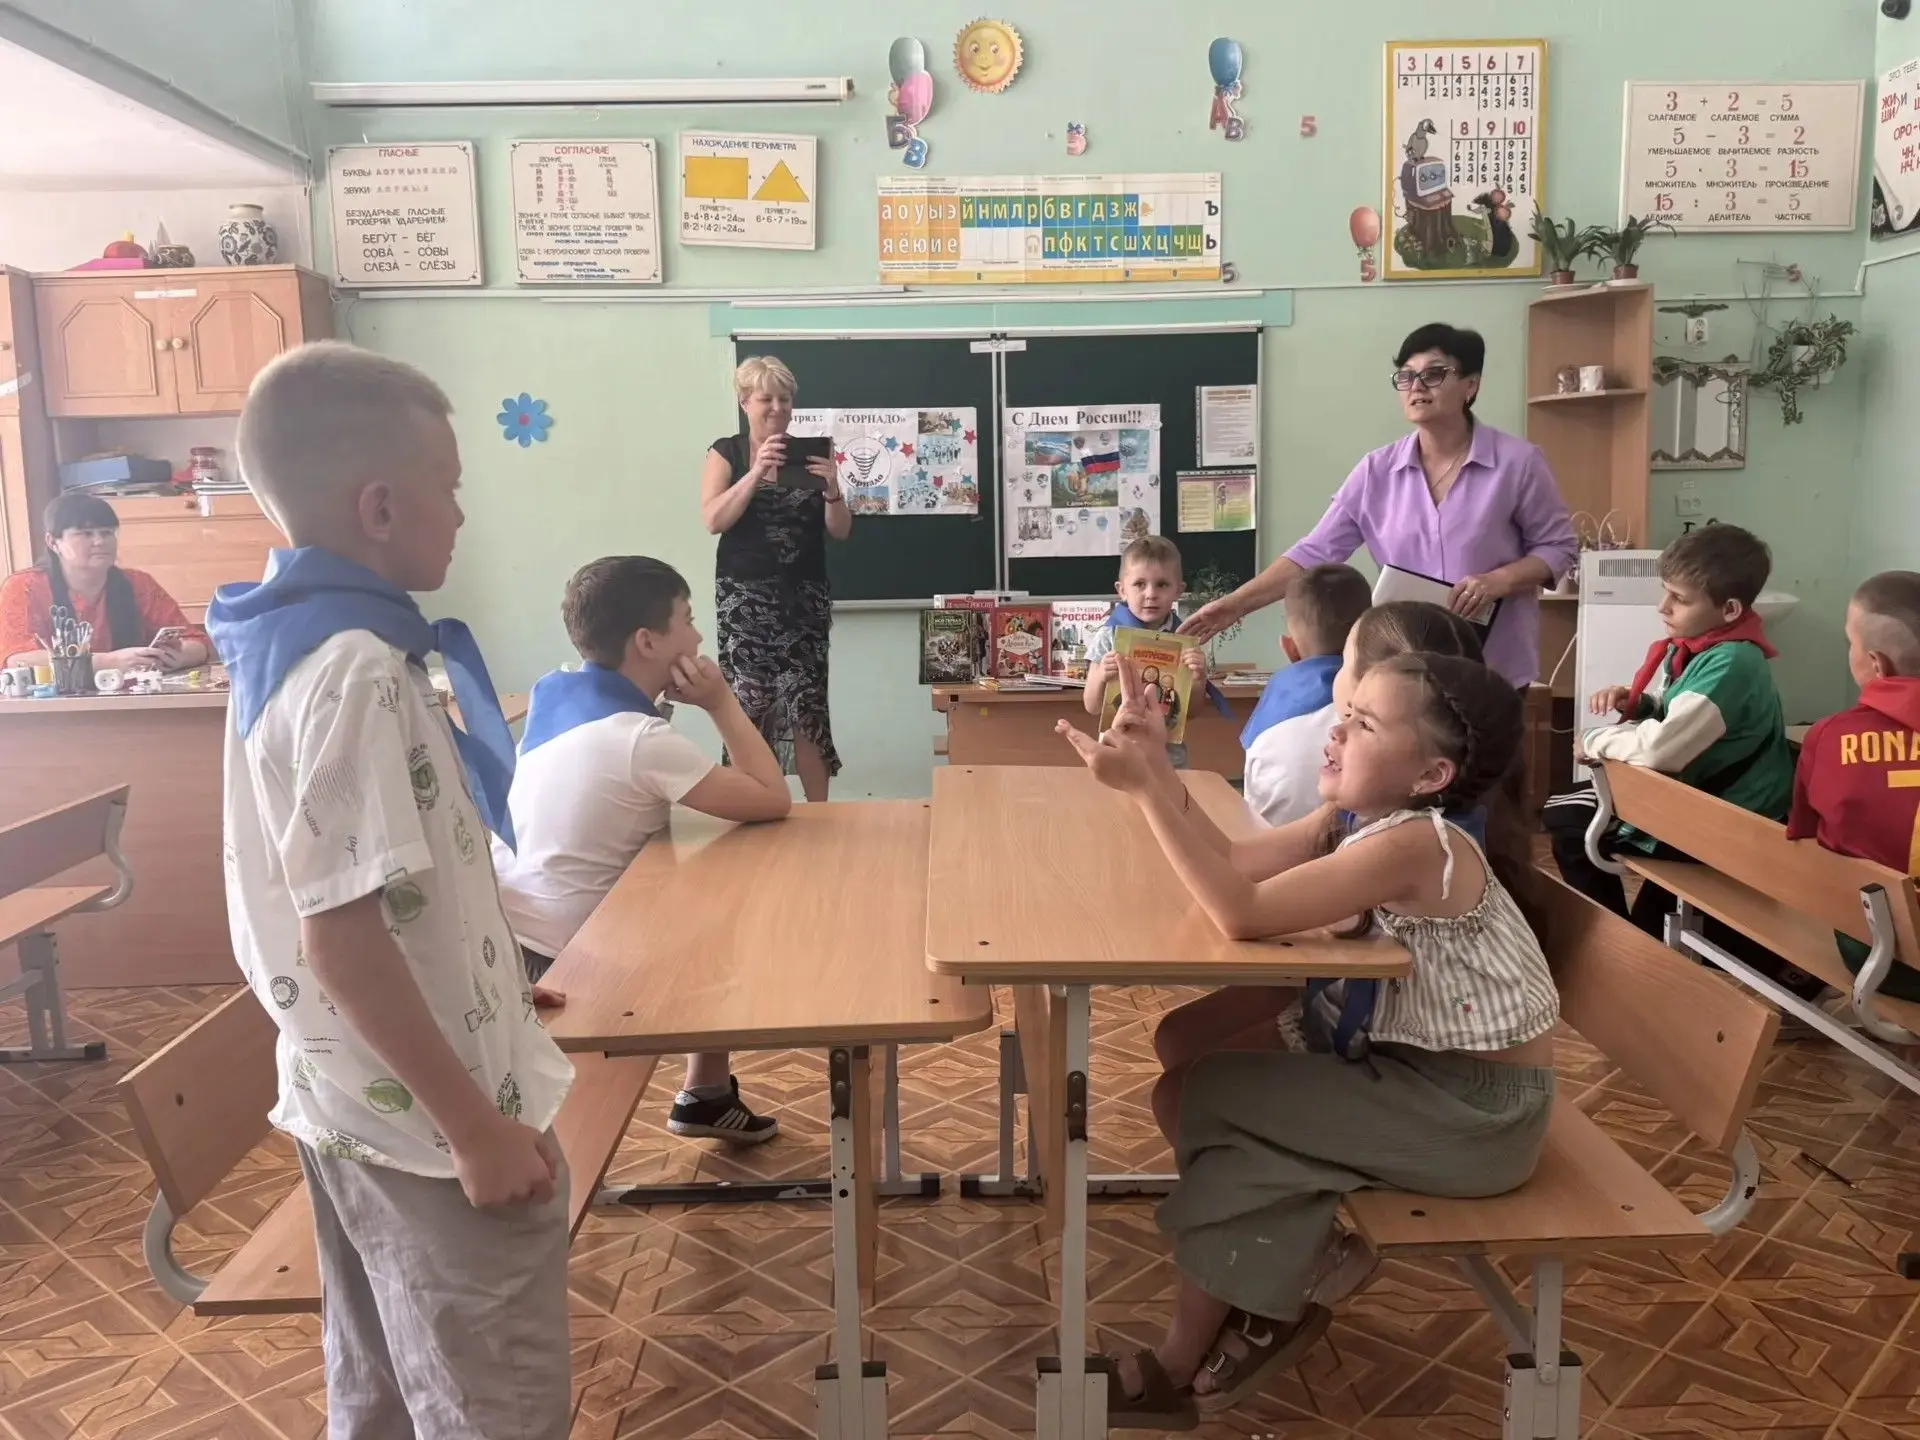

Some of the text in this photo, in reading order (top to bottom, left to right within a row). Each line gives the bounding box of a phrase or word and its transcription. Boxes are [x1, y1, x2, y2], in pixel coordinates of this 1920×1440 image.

[1407, 55, 1524, 71] 3 4 5 6 7
[1403, 77, 1408, 86] 2
[1430, 76, 1435, 85] 3
[1456, 76, 1461, 85] 4
[1483, 76, 1488, 84] 5
[1510, 76, 1516, 84] 6
[1430, 87, 1528, 97] 2 2 3 2 4 2 5 2
[1483, 98, 1528, 108] 3 3 4 3
[1666, 91, 1793, 112] 3 2 5
[1648, 114, 1800, 122] СЛАГАЕМОЕ СЛАГАЕМОЕ СУММА
[1881, 107, 1895, 123] ШИ
[1300, 116, 1317, 137] 5
[1460, 121, 1525, 135] 8 9 10
[1673, 126, 1805, 145] 5 3 2
[692, 139, 797, 150] НАХОЖДЕНИЕ ПЕРИМЕТРА
[1455, 141, 1460, 150] 7
[1482, 141, 1488, 149] 8
[1508, 140, 1514, 149] 9
[378, 149, 420, 158] ГЛАСНЫЕ
[554, 146, 610, 154] СОГЛАСНЫЕ
[1648, 148, 1711, 156] УМЕНЬШАЕМОЕ
[1455, 151, 1527, 161] 6 2 7 2 8 2
[1455, 163, 1526, 172] 5 3 6 3 7 3
[1666, 159, 1809, 178] 5 3 15
[1454, 174, 1525, 183] 4 4 5 4 6 4
[1507, 184, 1526, 193] 5 5
[1706, 181, 1757, 189] МНОЖИТЕЛЬ
[1765, 181, 1829, 189] ПРОИЗВЕДЕНИЕ
[1654, 191, 1801, 211] 15 3 5
[346, 207, 446, 218] БЕЗУДАРНЫЕ ГЛАСНЫЕ
[1708, 214, 1751, 222] ДЕЛИТЕЛЬ
[1775, 213, 1812, 221] ЧАСТНОЕ
[1222, 262, 1235, 283] 5
[839, 414, 906, 424] «ТОРНАДО»
[1012, 410, 1142, 426] С Днем России!!!
